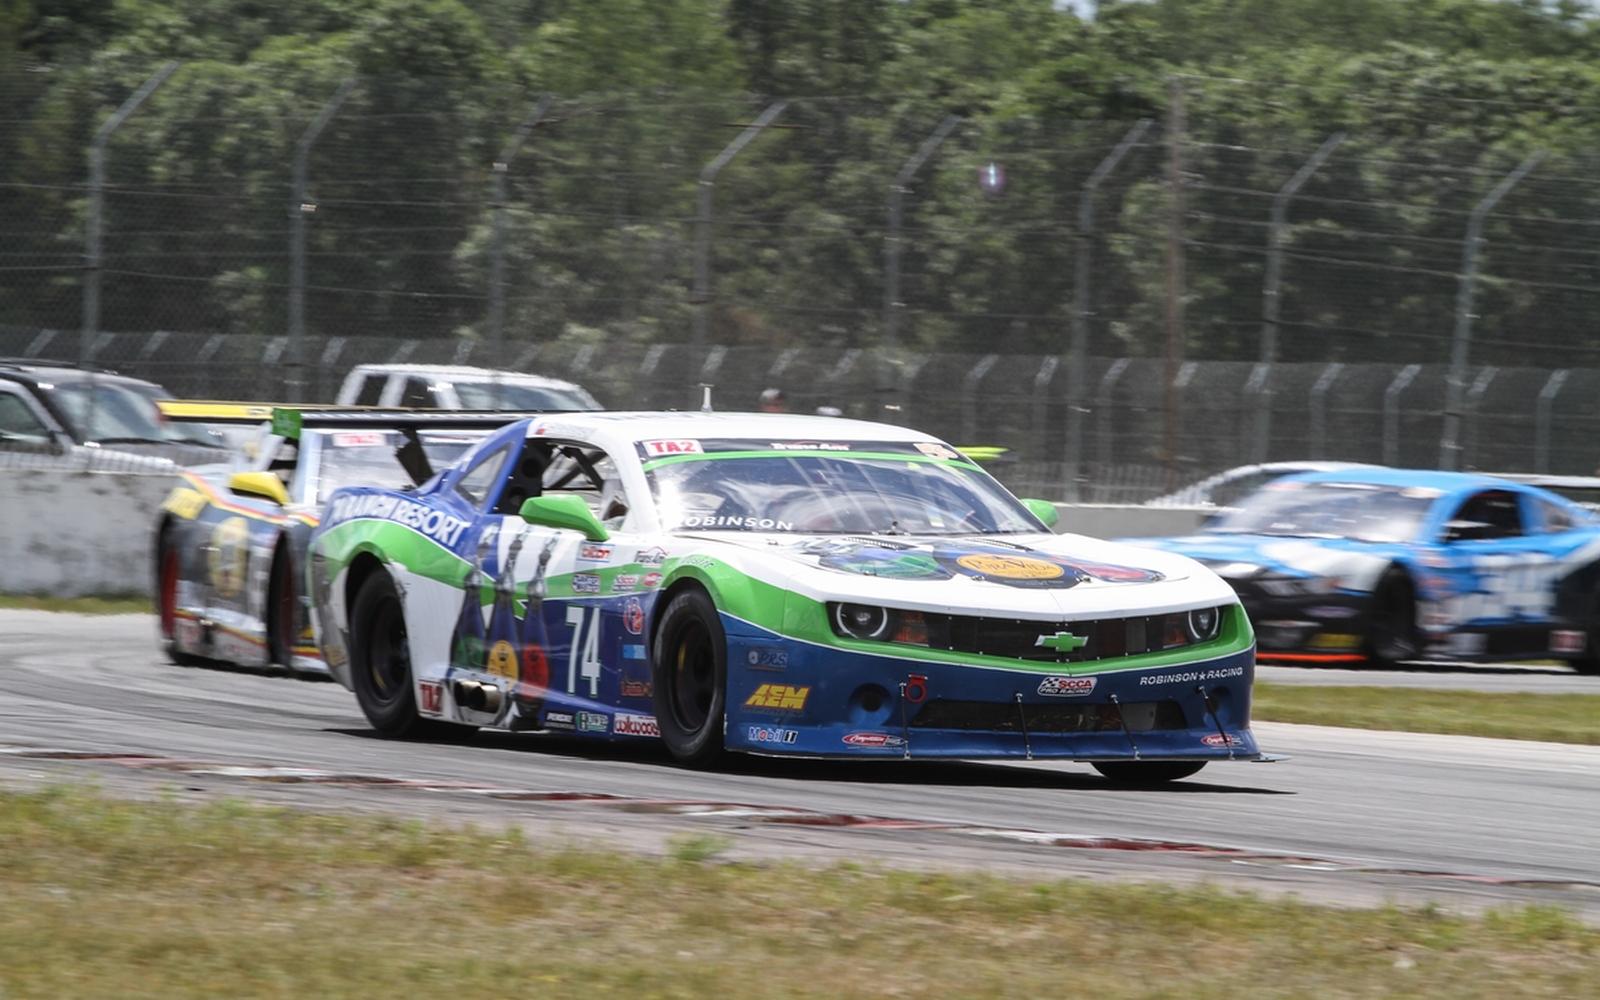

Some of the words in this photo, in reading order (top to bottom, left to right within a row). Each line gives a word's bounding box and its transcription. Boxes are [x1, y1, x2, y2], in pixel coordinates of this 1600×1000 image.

[651, 441, 697, 454] TA2
[392, 498, 472, 547] RESORT
[676, 516, 794, 531] OBINSON
[566, 605, 601, 697] 74
[1059, 680, 1092, 688] SCCA
[1139, 673, 1198, 686] ROBINSON
[1206, 667, 1244, 680] RACING
[745, 683, 810, 709] AEM
[748, 727, 782, 743] Mobil
[783, 729, 799, 744] 1
